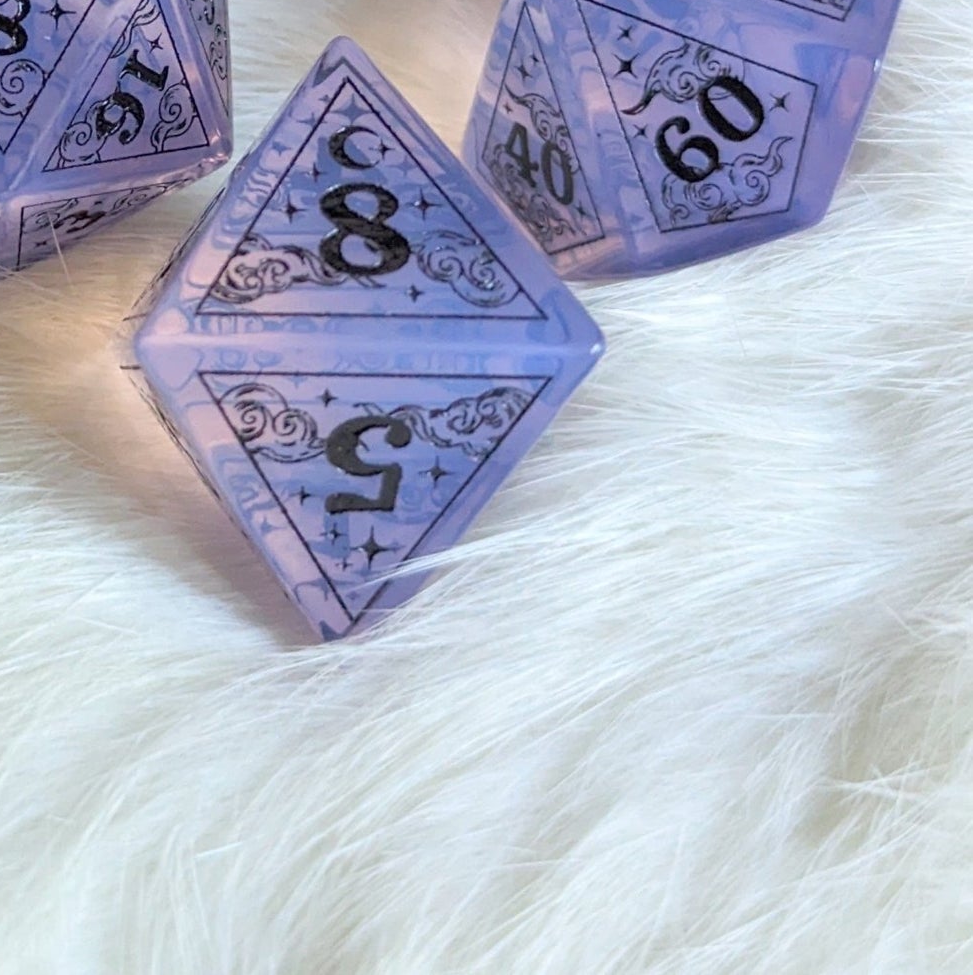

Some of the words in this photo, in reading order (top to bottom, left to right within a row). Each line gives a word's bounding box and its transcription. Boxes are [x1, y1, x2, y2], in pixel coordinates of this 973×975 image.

[95, 48, 169, 145] 16
[655, 73, 765, 184] 60
[505, 123, 575, 205] 40
[319, 182, 410, 276] 8
[325, 414, 412, 514] 5
